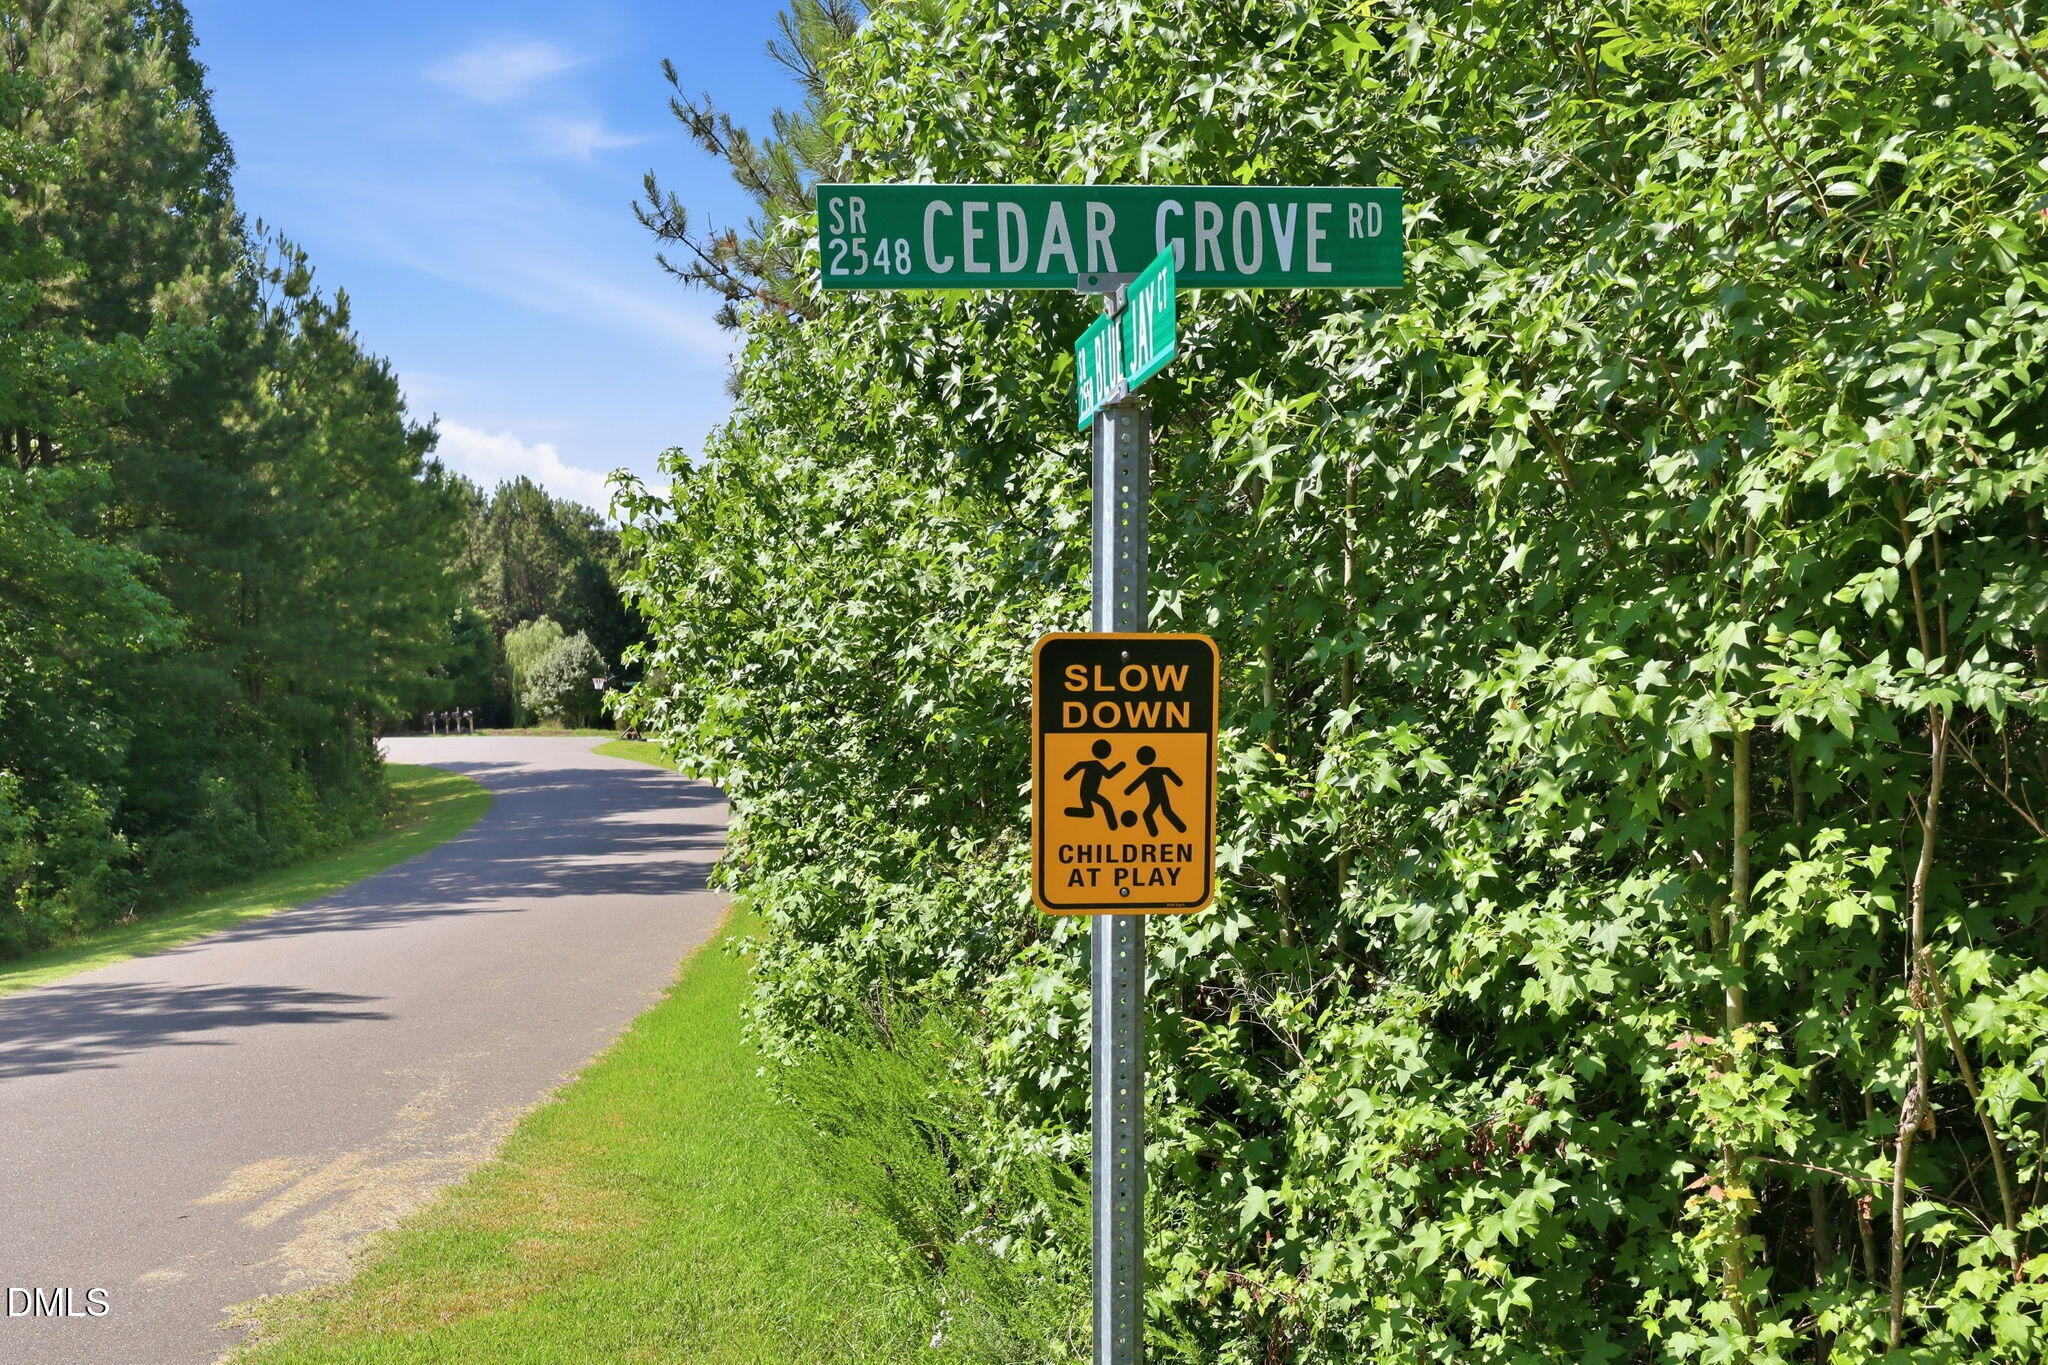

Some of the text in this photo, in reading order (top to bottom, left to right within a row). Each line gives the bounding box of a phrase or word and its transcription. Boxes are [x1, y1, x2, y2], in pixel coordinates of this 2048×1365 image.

[828, 196, 867, 235] SR
[923, 199, 1383, 275] CEDAR GROVE RD
[828, 237, 912, 276] 2548
[1094, 267, 1168, 402] BLUE JAY CT
[1063, 664, 1189, 692] SLOW
[1062, 701, 1190, 729] DOWN
[1058, 843, 1193, 864] CHILDREN
[1067, 867, 1182, 888] AT PLAY
